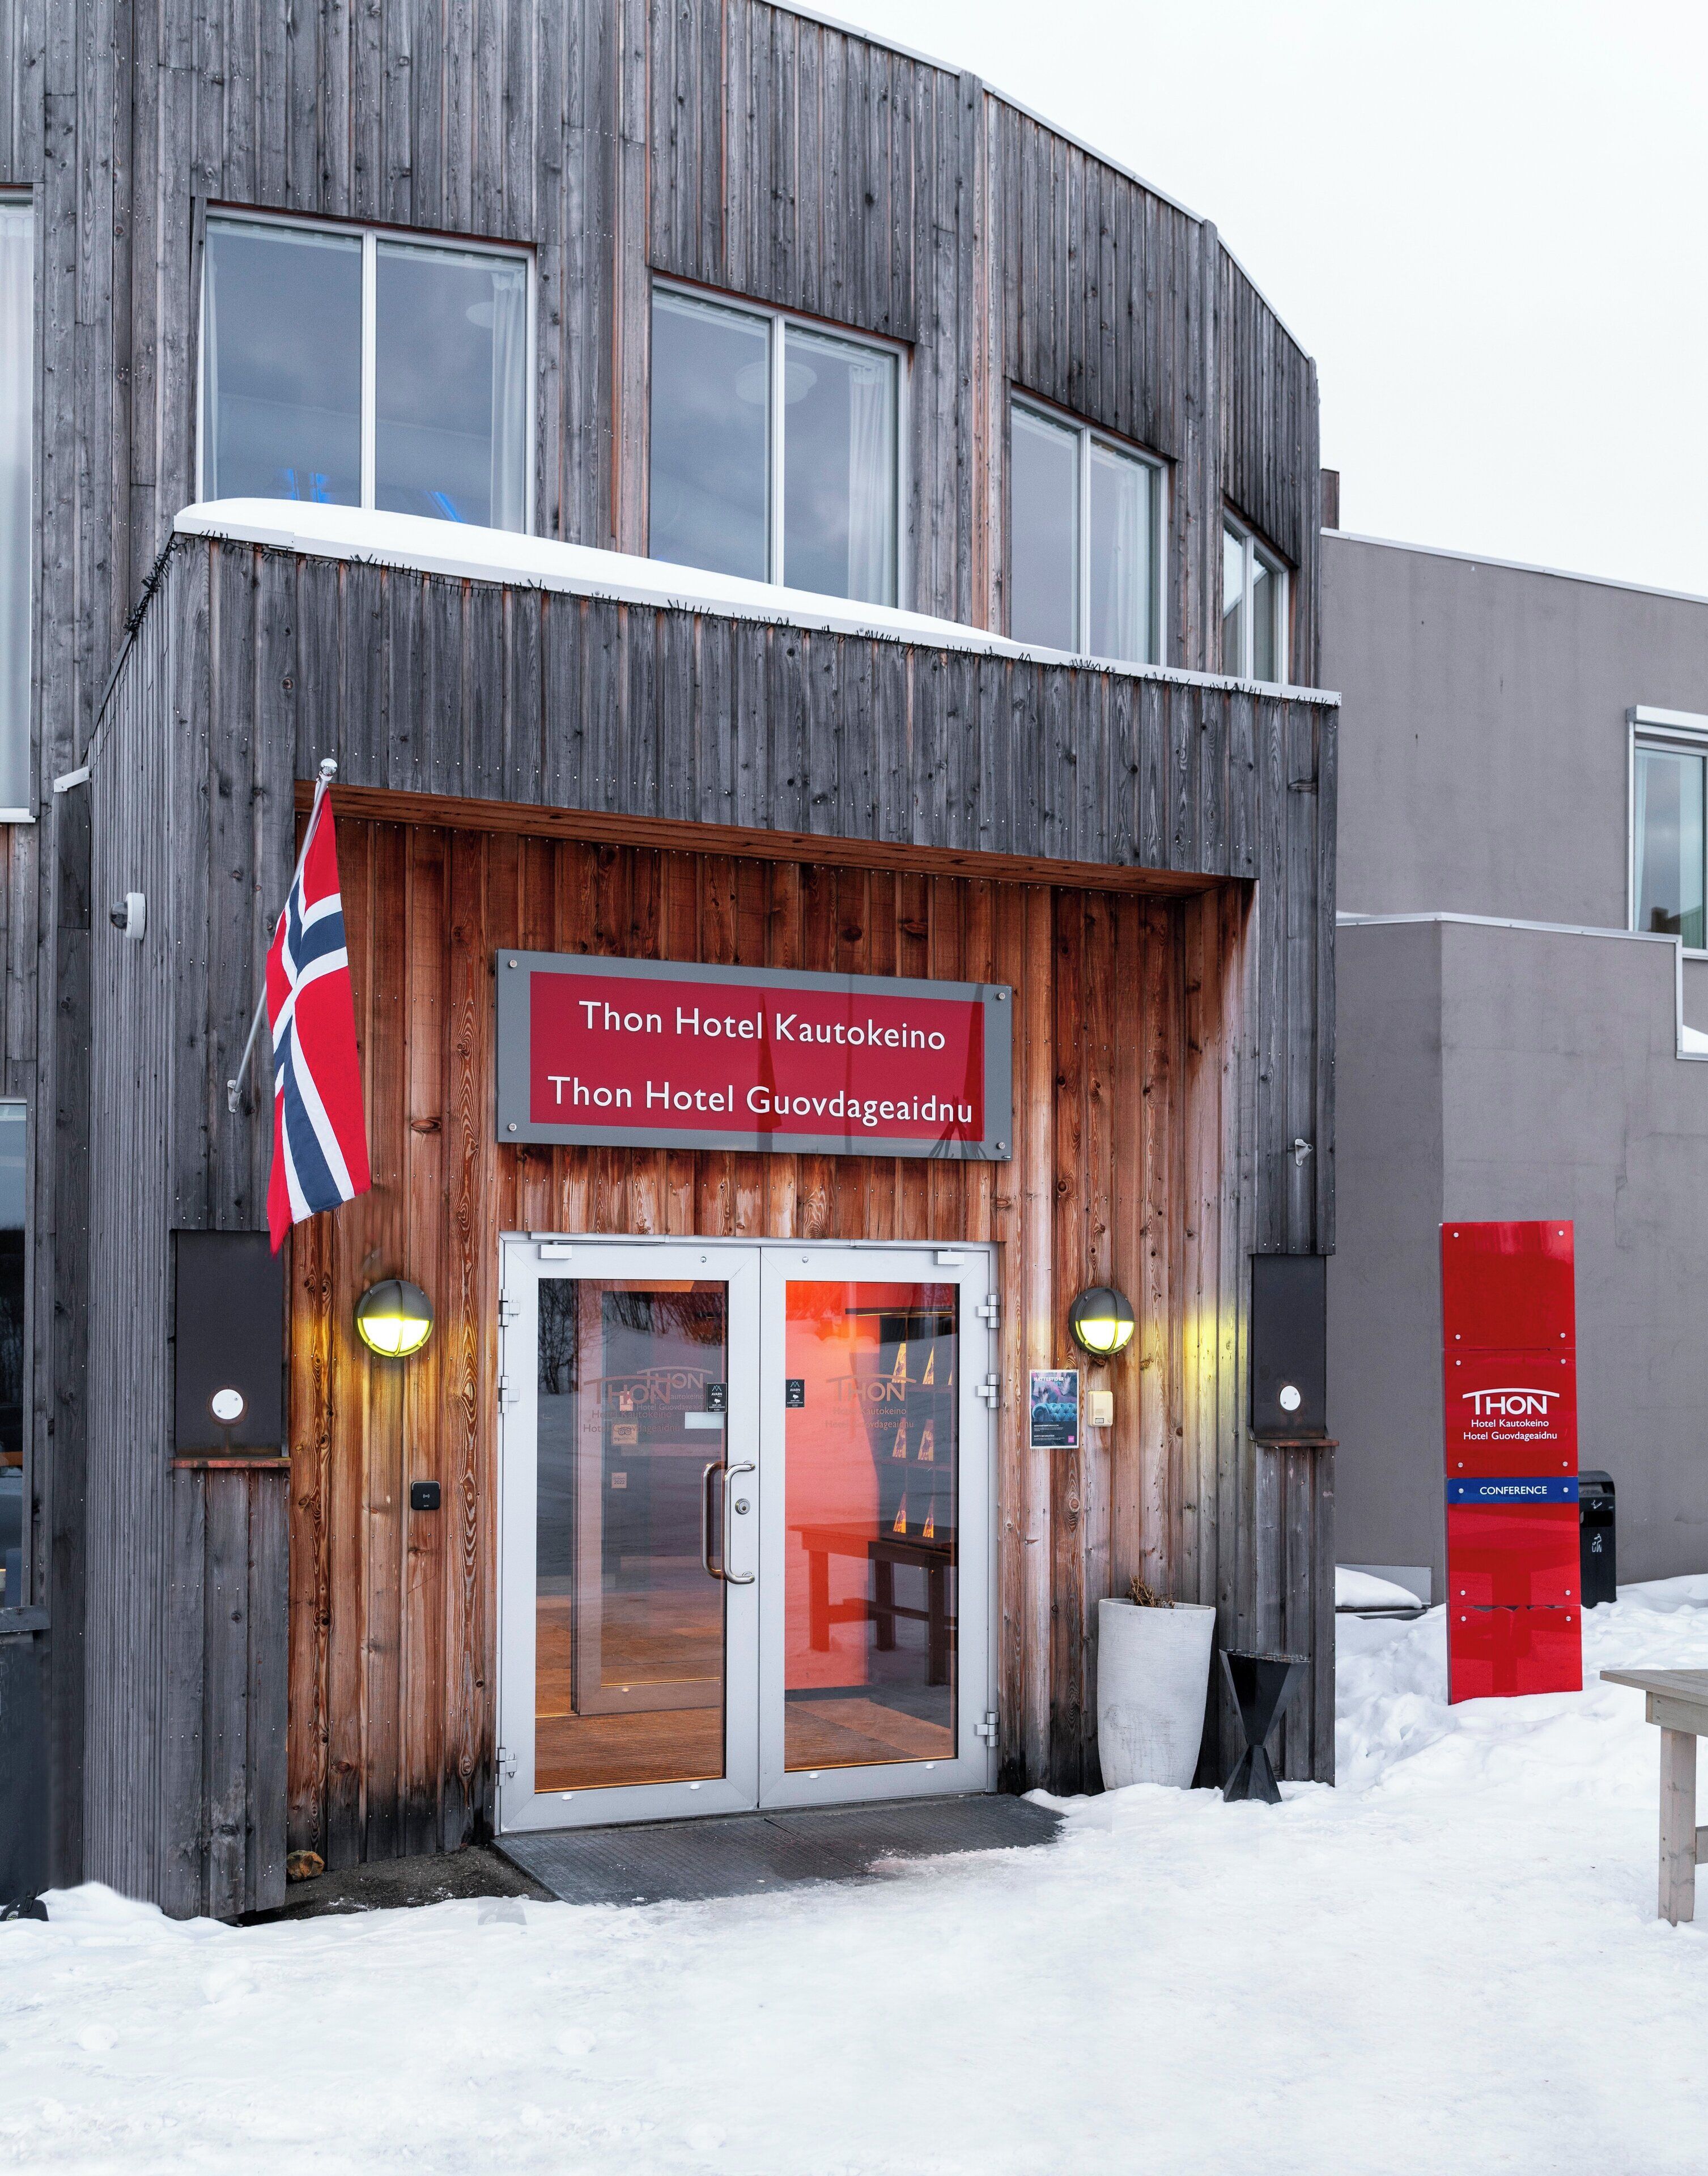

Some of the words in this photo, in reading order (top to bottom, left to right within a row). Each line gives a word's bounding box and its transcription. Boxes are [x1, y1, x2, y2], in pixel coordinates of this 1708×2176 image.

[579, 1000, 662, 1033] Thon
[676, 1006, 762, 1039] Hotel
[776, 1013, 945, 1050] Kautokeino
[547, 1076, 632, 1108] Thon
[647, 1081, 733, 1112] Hotel
[746, 1086, 972, 1127] Guovdageaidnu
[637, 1366, 713, 1389] THON
[584, 1375, 683, 1404] THON
[826, 1373, 916, 1401] THON
[1463, 1388, 1560, 1415] THON
[861, 1406, 907, 1415] Kautokeino
[613, 1424, 680, 1434] Gvdageaidnu
[852, 1420, 914, 1430] ovdageaidnu
[1471, 1419, 1496, 1427] Hotel
[1499, 1418, 1549, 1427] Kautokeino
[1463, 1431, 1488, 1440] Hotel
[1491, 1431, 1557, 1442] Guovdageaidnu
[1479, 1486, 1548, 1495] CONFERENCE
